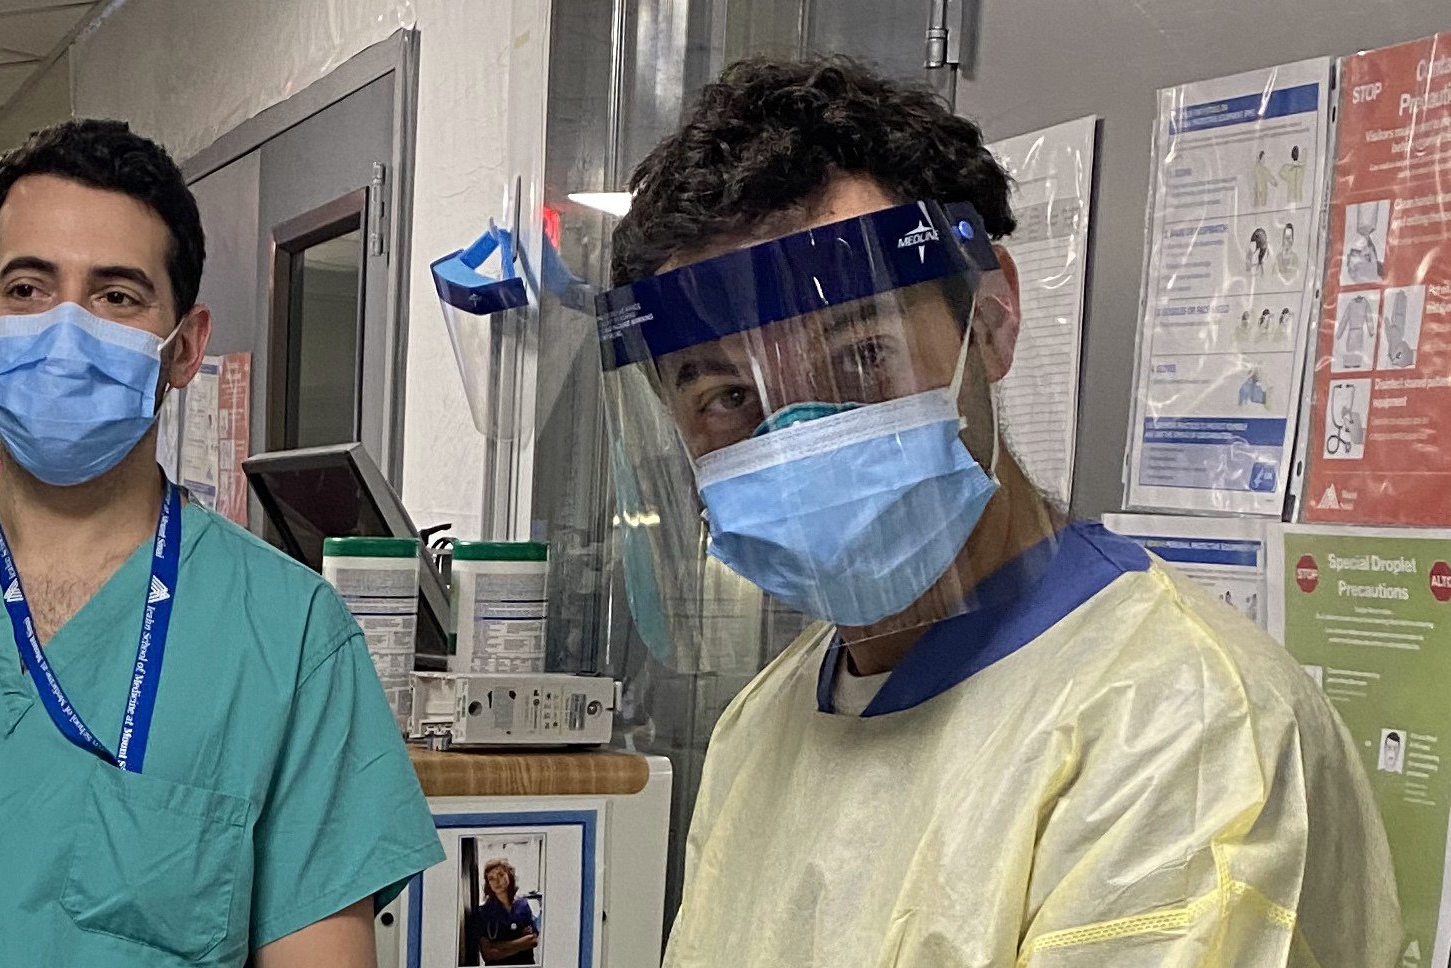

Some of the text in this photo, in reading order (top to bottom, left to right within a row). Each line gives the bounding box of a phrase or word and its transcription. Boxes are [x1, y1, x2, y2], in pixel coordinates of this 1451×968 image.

[1352, 82, 1382, 104] STOP
[897, 230, 939, 248] MEDLINE
[158, 513, 169, 537] Mount
[155, 536, 166, 559] Sinai
[1297, 568, 1318, 580] STOP
[1328, 553, 1417, 576] Special Droplet
[1338, 580, 1409, 601] Precautions
[144, 605, 156, 631] Icahn
[138, 630, 151, 662] School
[136, 661, 146, 675] of
[127, 674, 144, 714] Medicine
[62, 704, 74, 718] of
[125, 714, 134, 727] at
[68, 713, 94, 742] School
[118, 726, 133, 759] Mount
